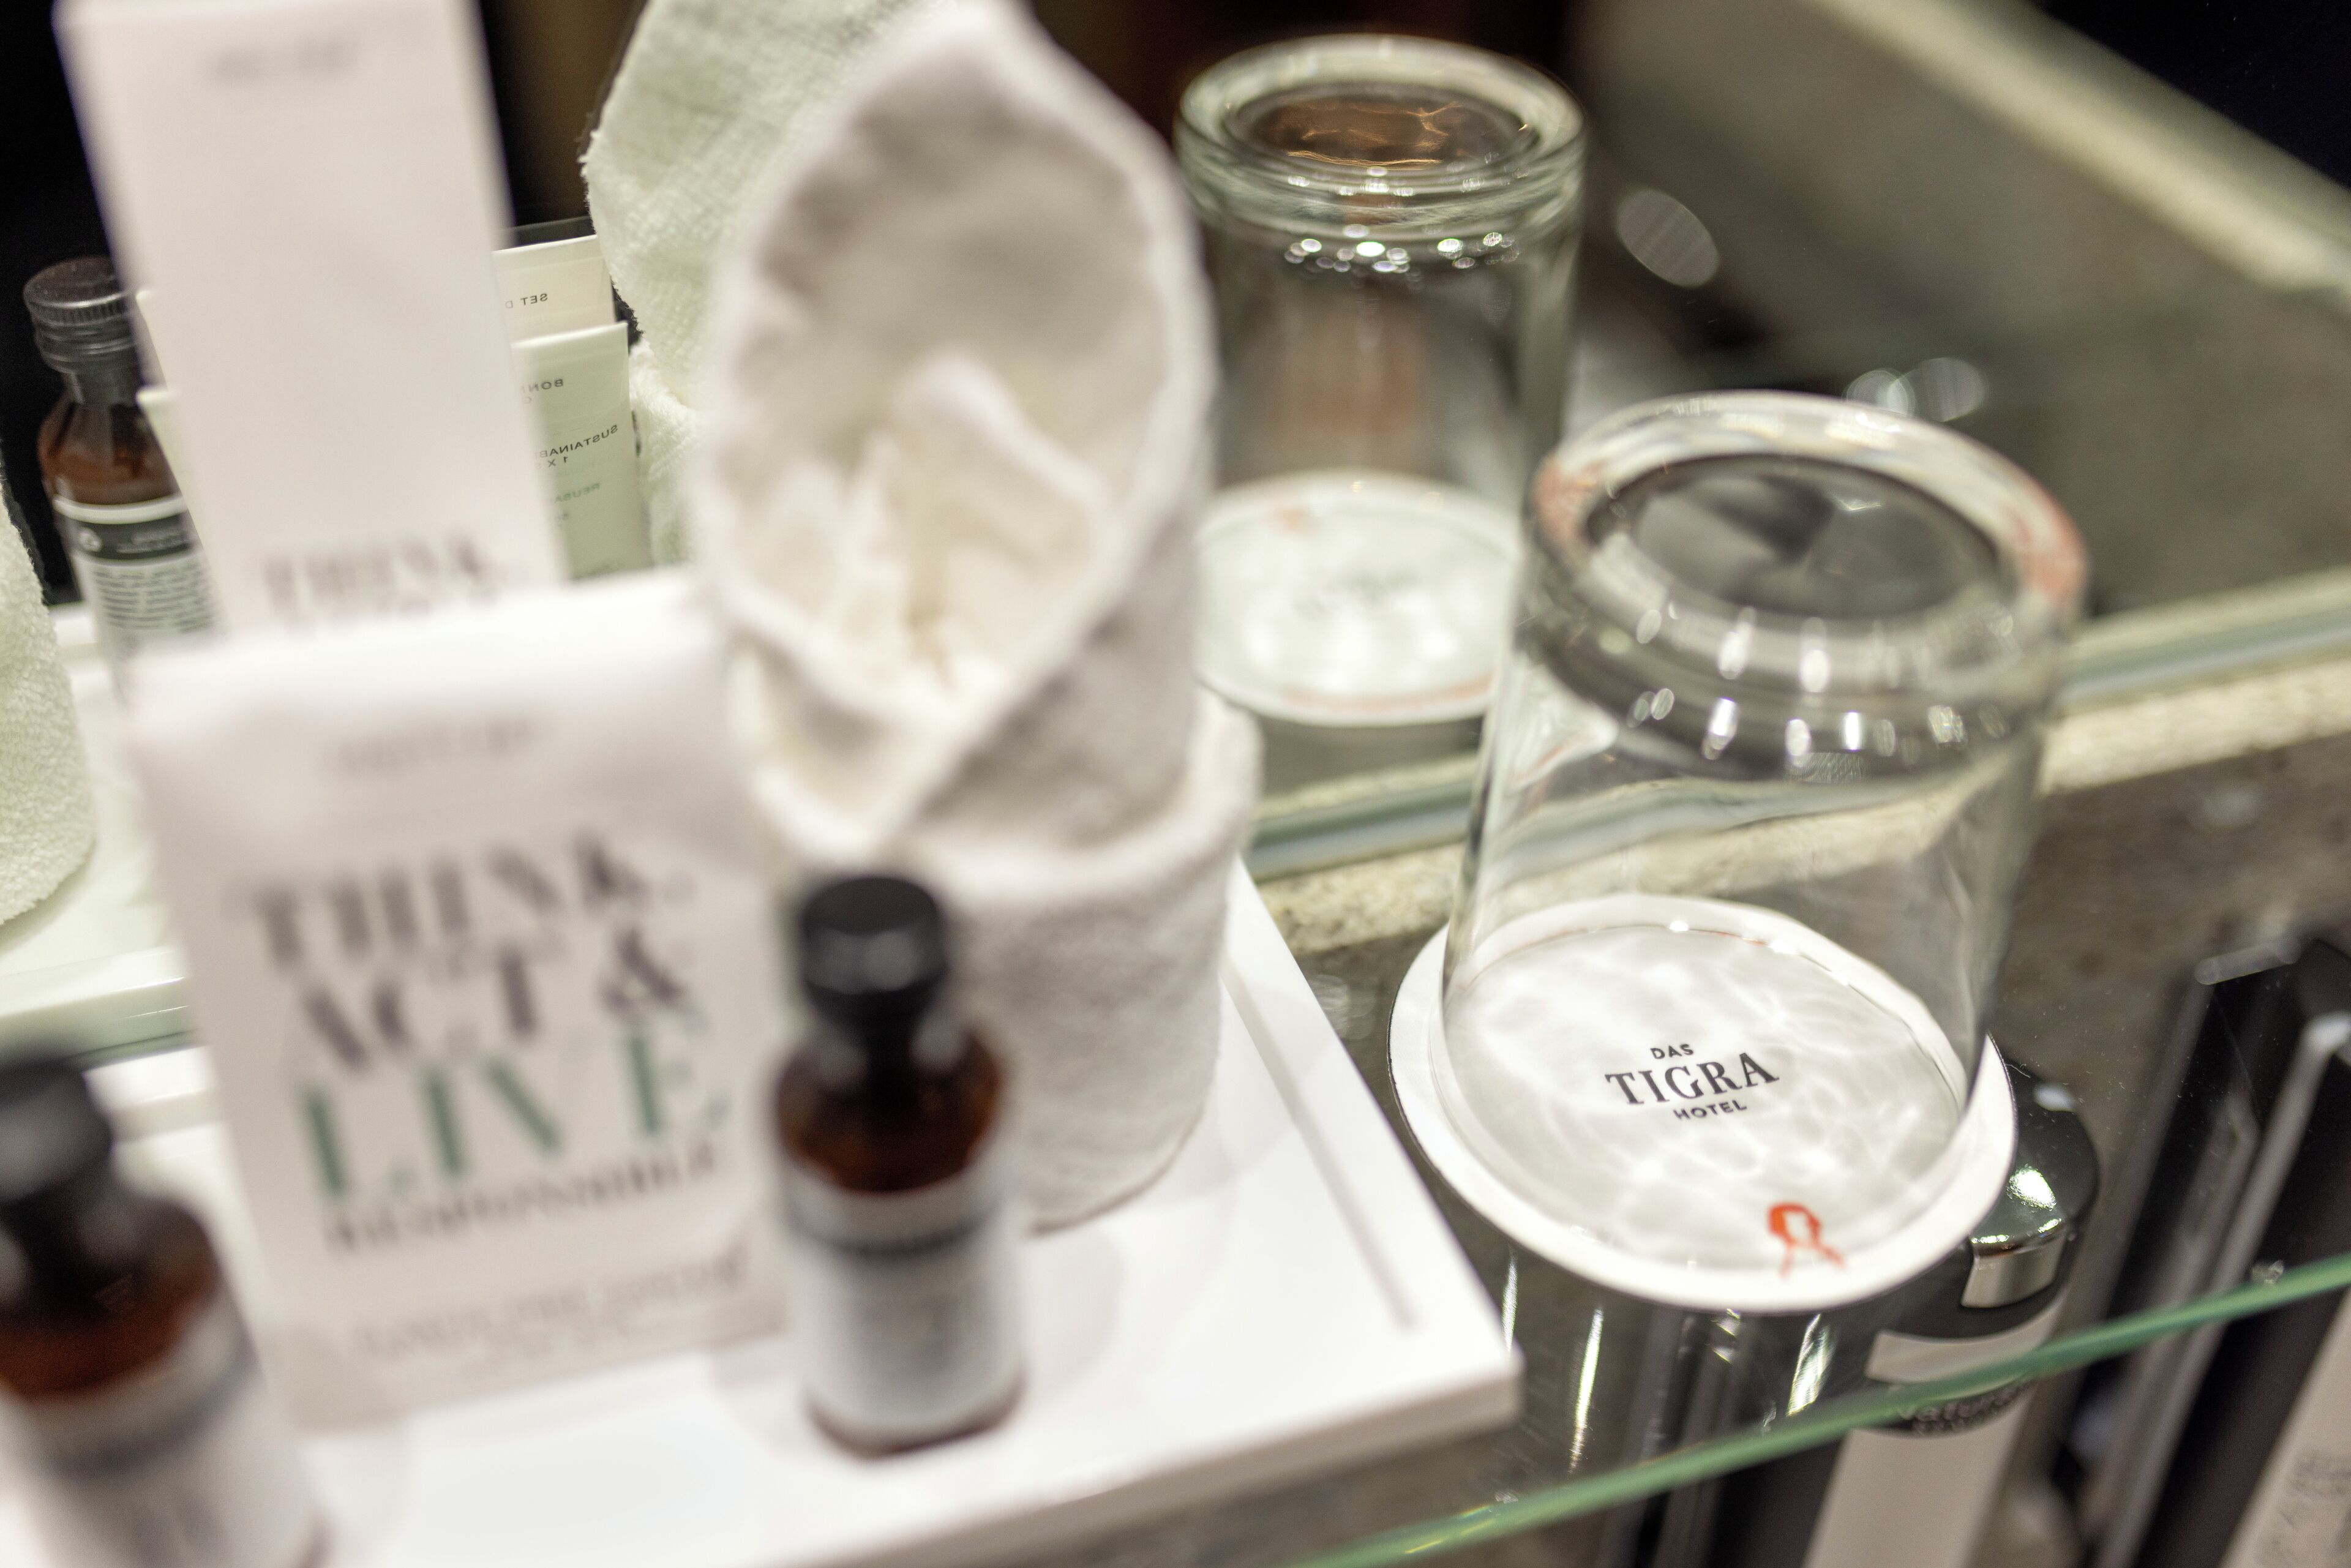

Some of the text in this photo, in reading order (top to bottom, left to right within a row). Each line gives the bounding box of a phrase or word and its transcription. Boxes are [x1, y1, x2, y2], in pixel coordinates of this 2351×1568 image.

[1651, 1044, 1693, 1060] DAS
[1605, 1052, 1780, 1105] TIGRA
[1673, 1100, 1747, 1120] HOTEL
